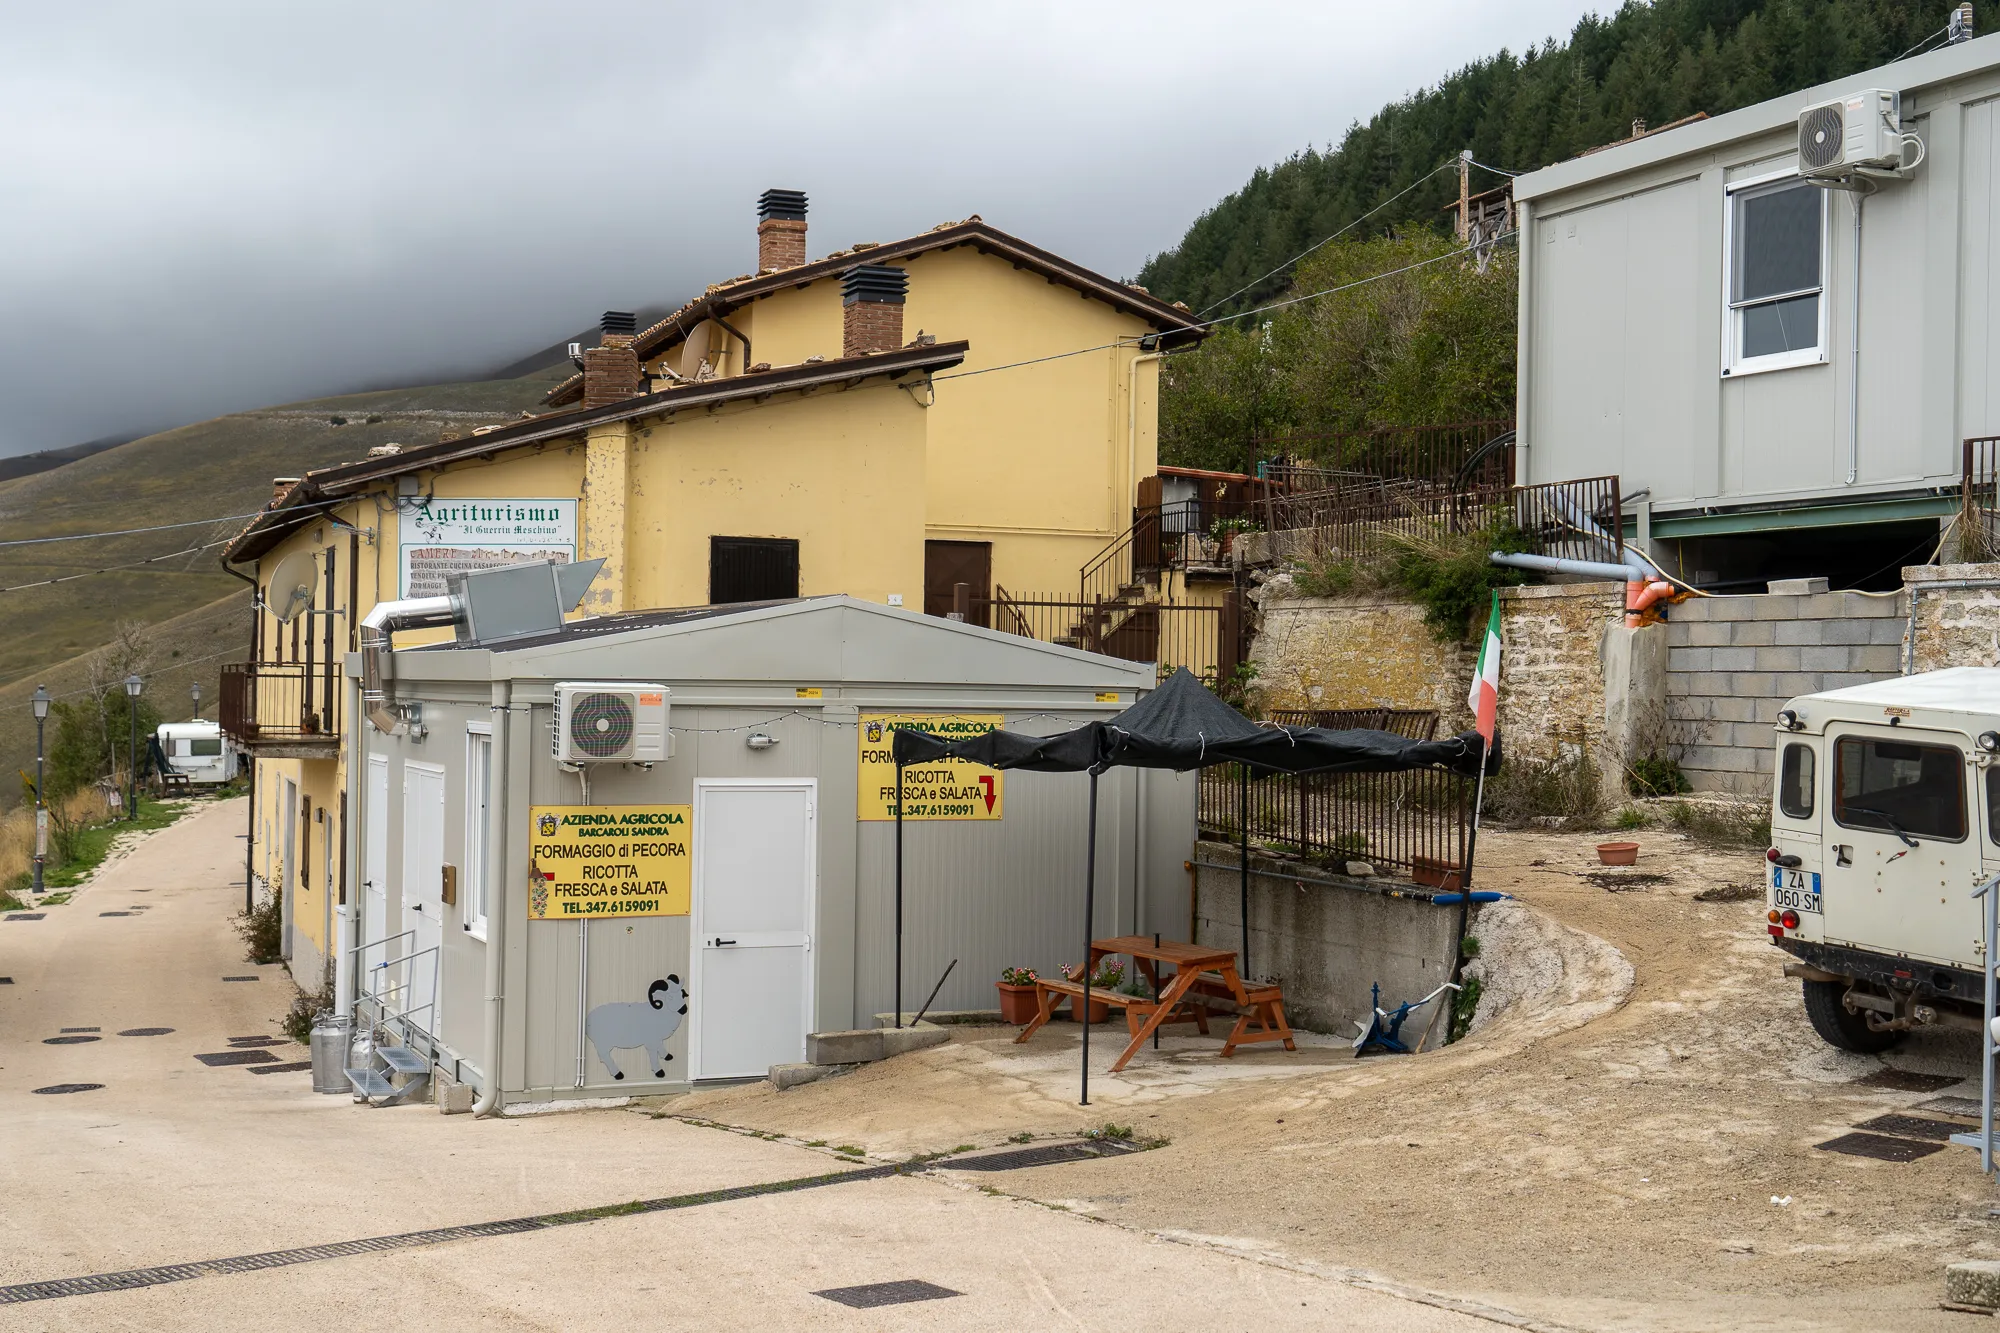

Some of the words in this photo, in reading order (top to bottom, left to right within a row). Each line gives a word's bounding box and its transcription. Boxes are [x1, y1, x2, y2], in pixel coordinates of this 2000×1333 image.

[415, 504, 559, 525] Agriturismo
[475, 525, 511, 534] Guerrin
[410, 548, 457, 559] CAMERE
[938, 722, 996, 732] AGRICOLA
[904, 770, 955, 783] RICOTTA
[880, 786, 927, 800] FRSCA
[930, 790, 936, 800] e
[939, 786, 982, 800] SALATA
[561, 814, 617, 826] AZIENDA
[619, 813, 684, 825] AGRICOLA
[578, 828, 629, 837] BARCAROLI
[631, 827, 669, 836] SANDRA
[534, 844, 615, 859] FORMAGGIO
[618, 844, 629, 858] di
[632, 843, 686, 857] PECORA
[583, 865, 638, 879] RICOTTA
[1788, 871, 1805, 889] ZA
[555, 882, 608, 897] FRESCA
[610, 885, 618, 896] e
[620, 881, 668, 895] SALATA
[562, 900, 659, 914] TEL.347.6159091
